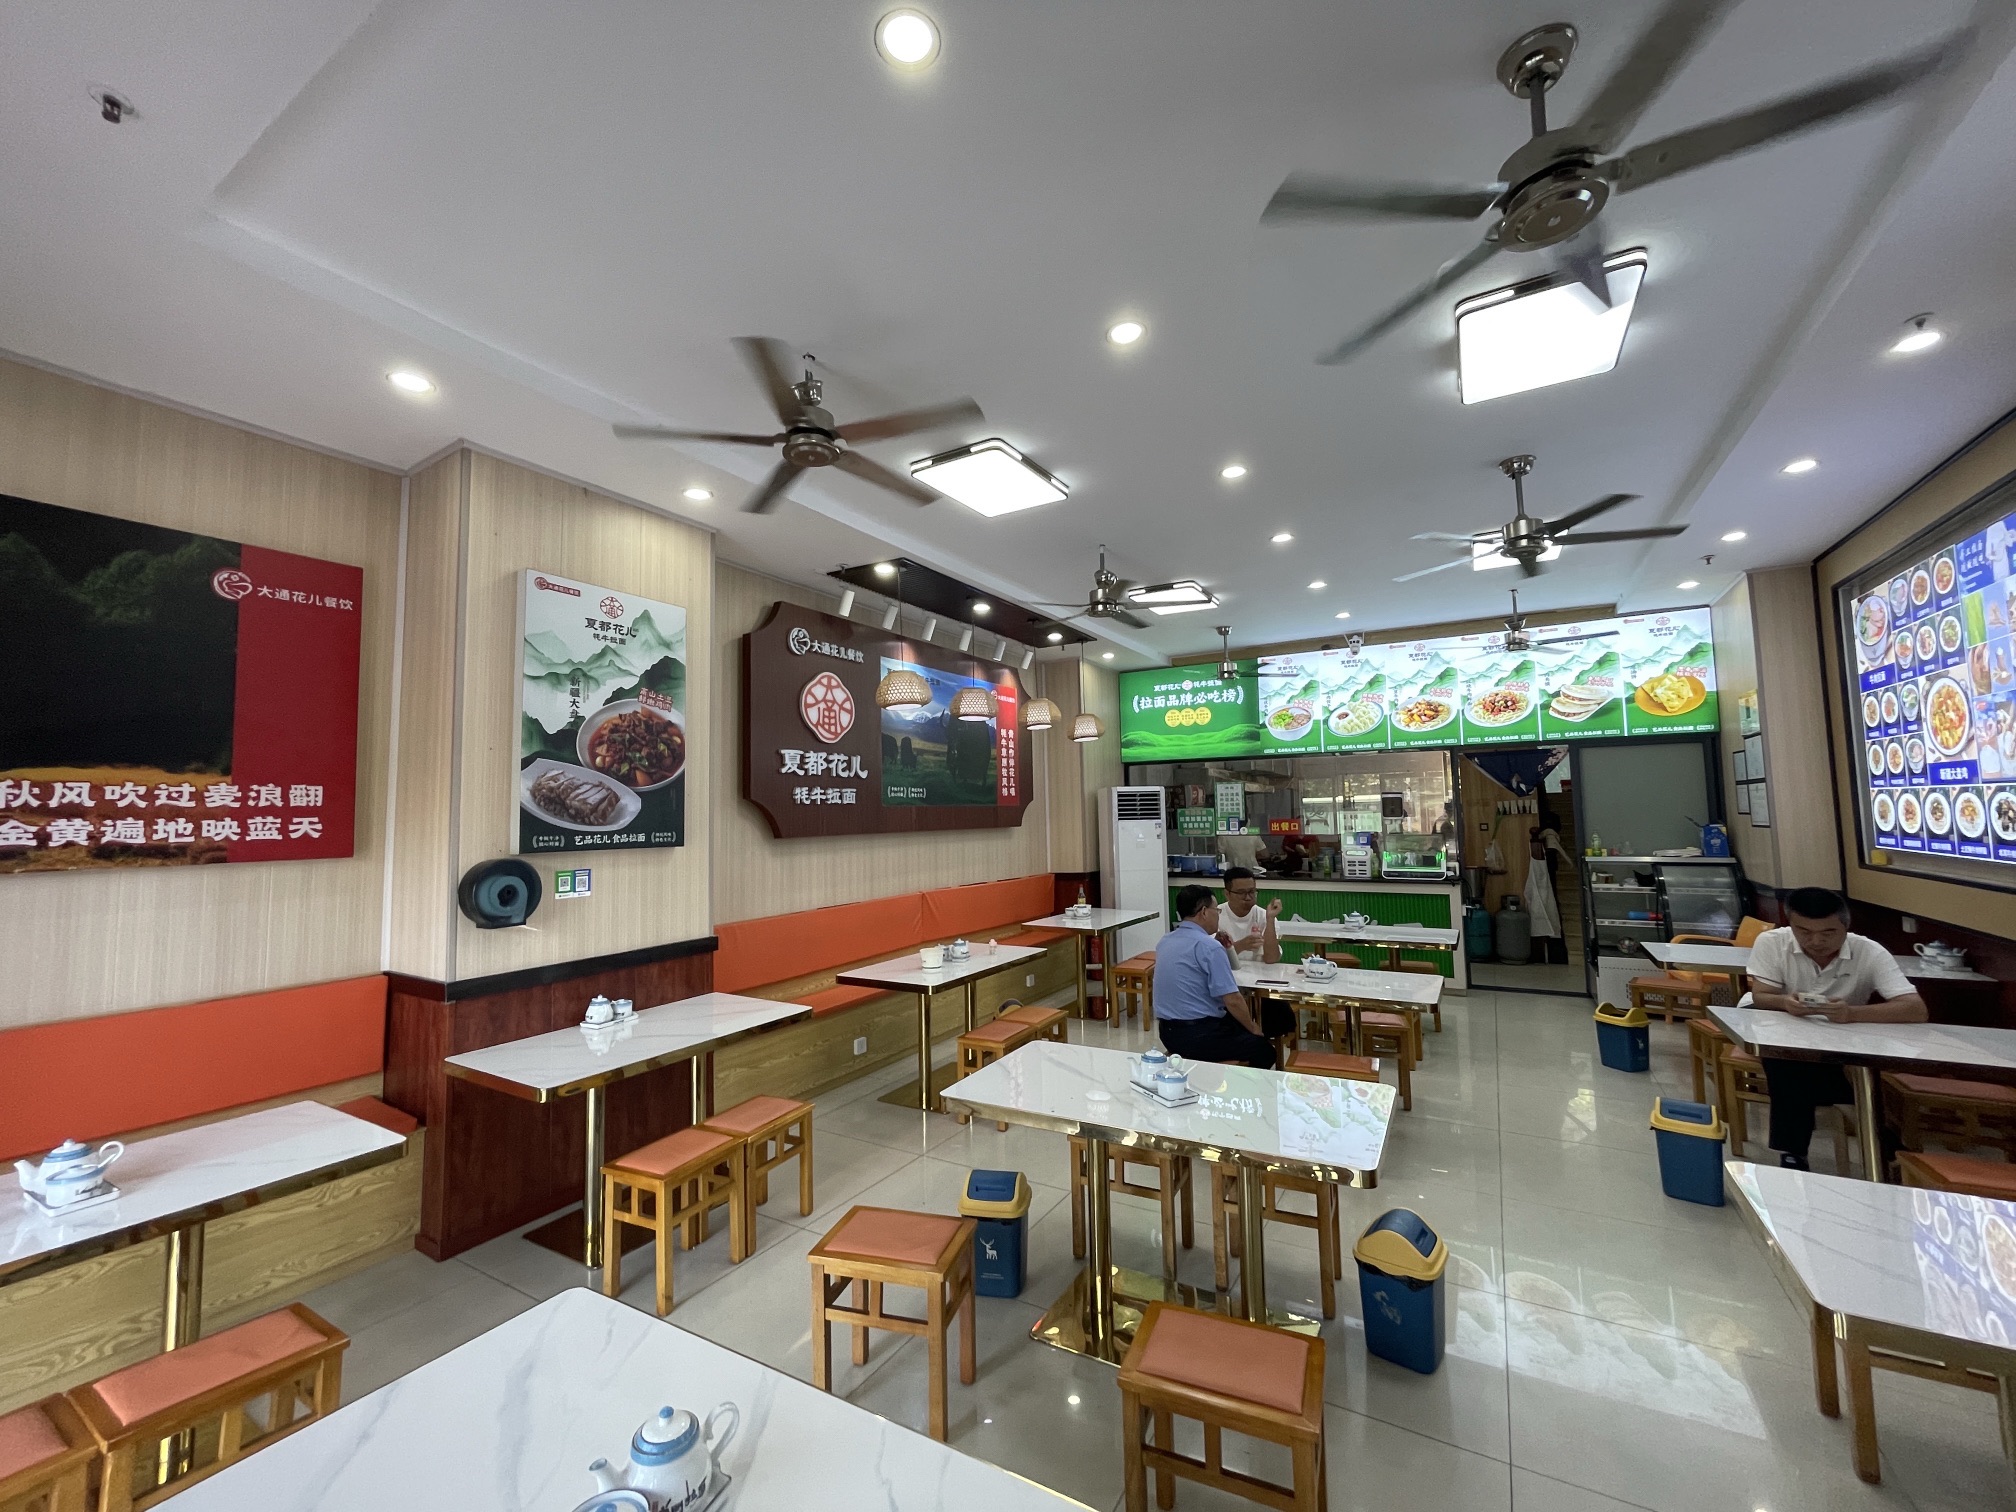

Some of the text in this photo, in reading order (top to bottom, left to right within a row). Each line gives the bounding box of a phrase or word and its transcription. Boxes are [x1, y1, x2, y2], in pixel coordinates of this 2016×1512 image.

[257, 584, 354, 611] 大通花儿餐饮
[585, 617, 638, 638] 夏都花儿
[593, 632, 627, 646] 牦牛拉面
[811, 640, 865, 664] 大通花儿餐饮
[1139, 688, 1237, 709] 拉面品牌必吃榜
[779, 749, 868, 780] 夏都花儿
[0, 779, 323, 808] 秋风吹过麦浪翻
[794, 786, 857, 805] 牦牛拉面
[0, 817, 322, 846] 金黄遍地映蓝天
[1271, 823, 1299, 831] 出餐口
[574, 836, 610, 846] 艺品花儿
[612, 833, 647, 843] 食品拉面
